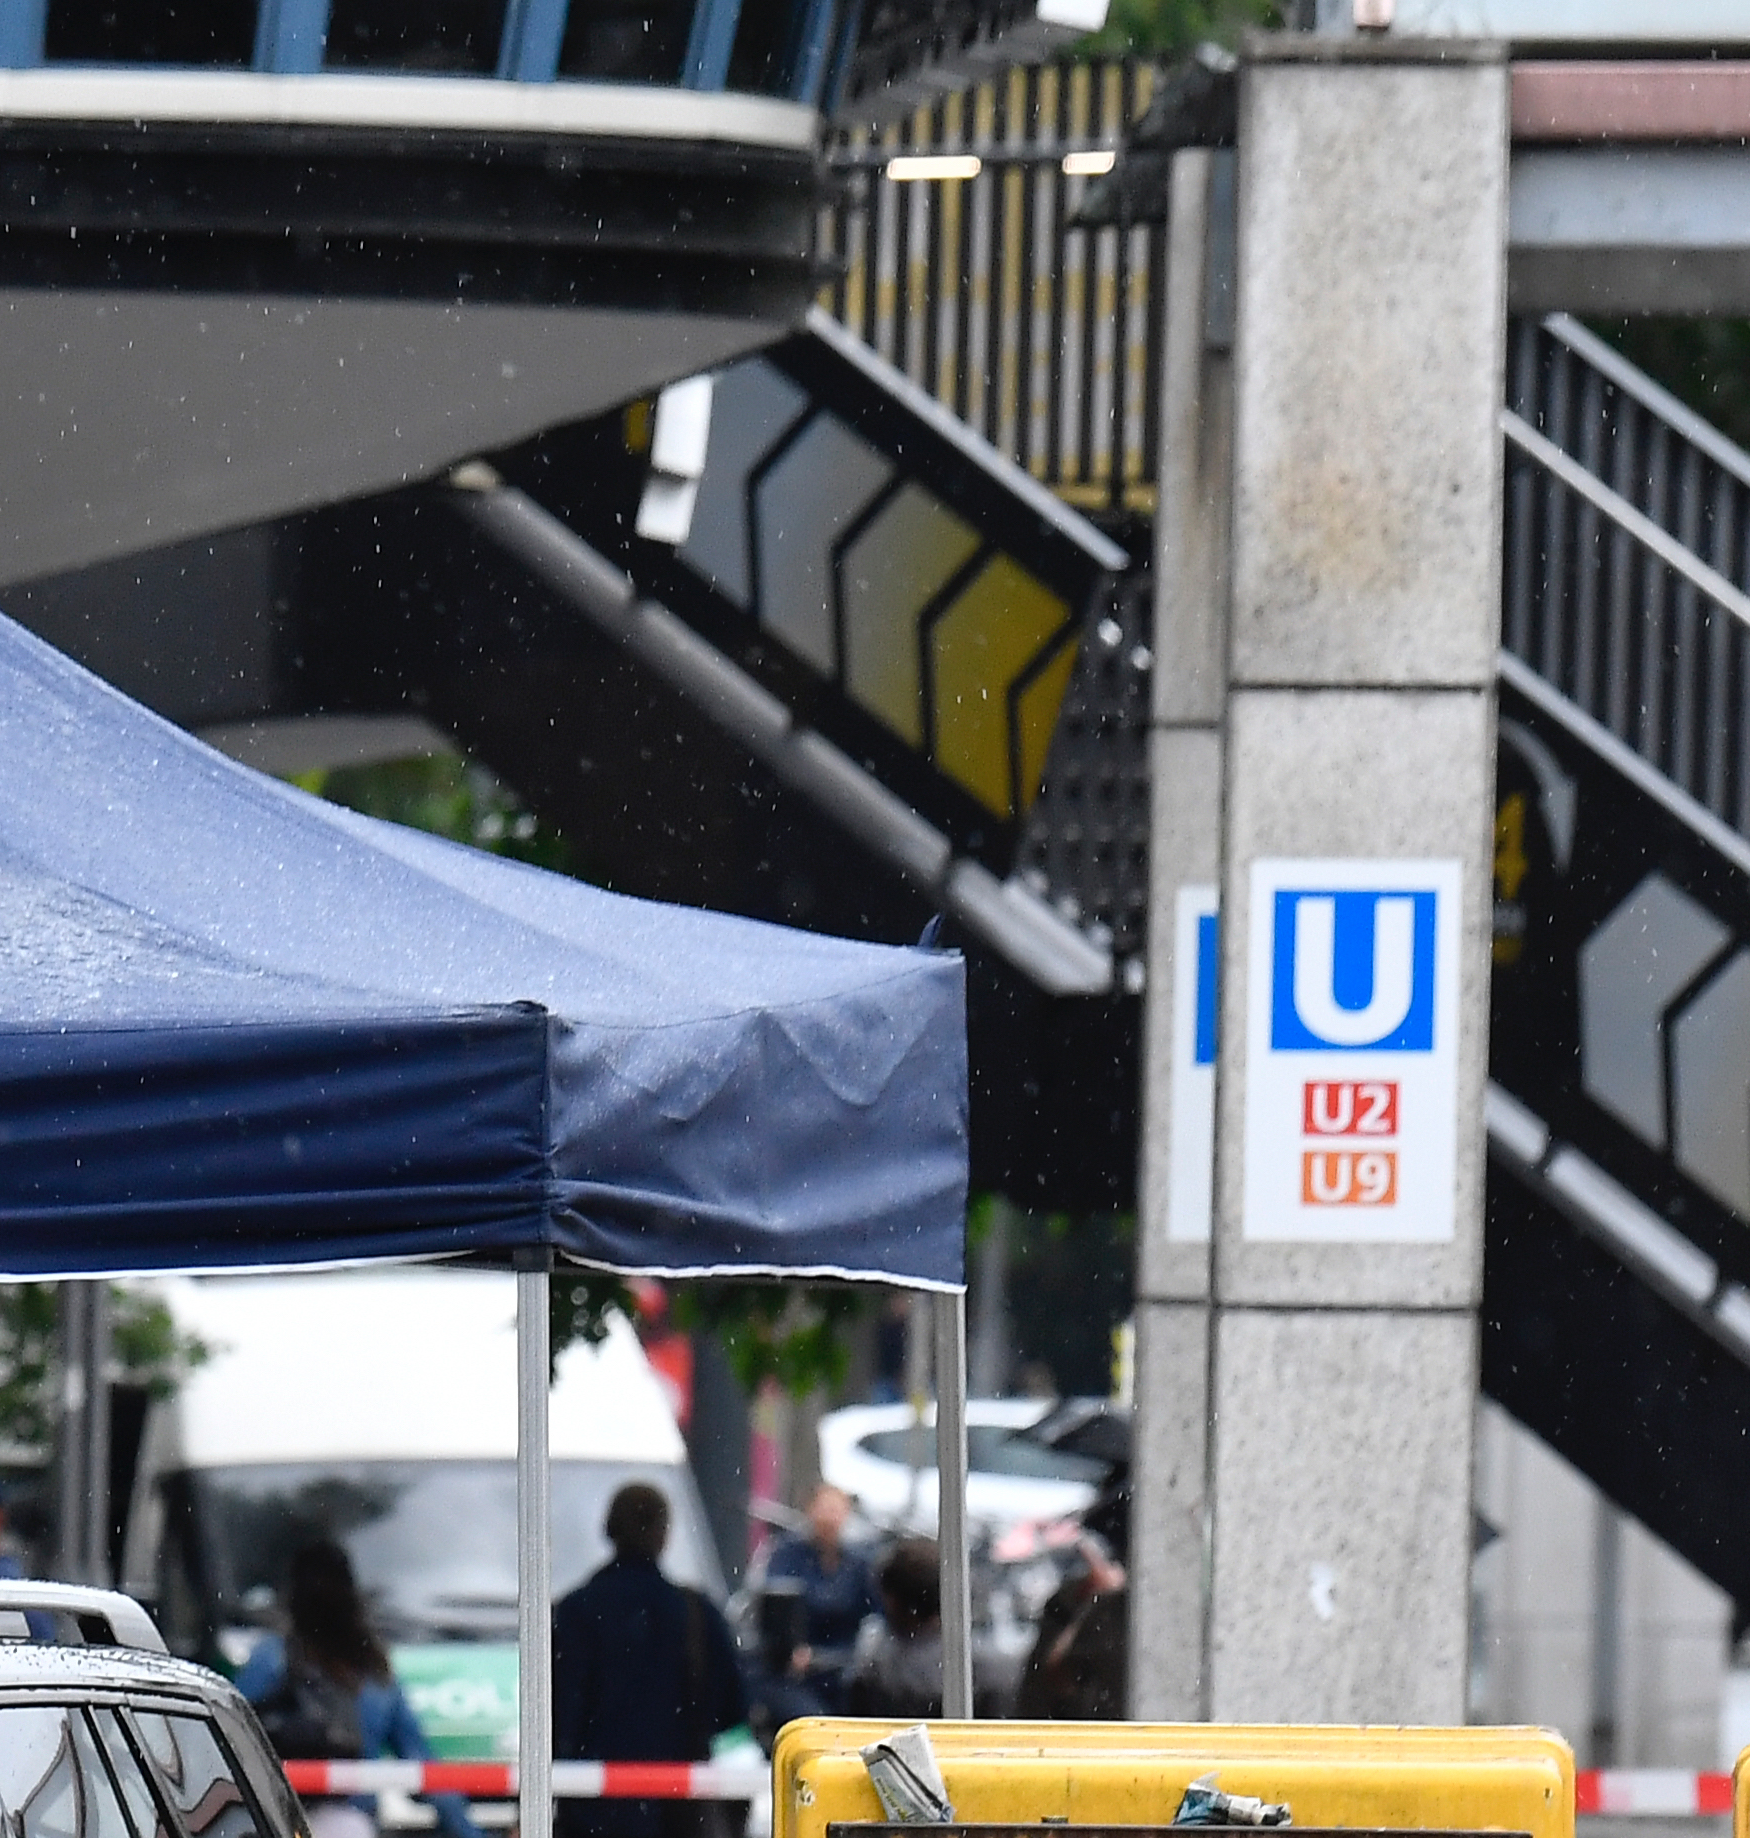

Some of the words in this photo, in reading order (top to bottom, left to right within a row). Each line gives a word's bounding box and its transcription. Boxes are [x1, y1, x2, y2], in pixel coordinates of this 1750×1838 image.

[1293, 897, 1415, 1047] U
[1311, 1084, 1392, 1134] U2
[1310, 1154, 1391, 1202] U9
